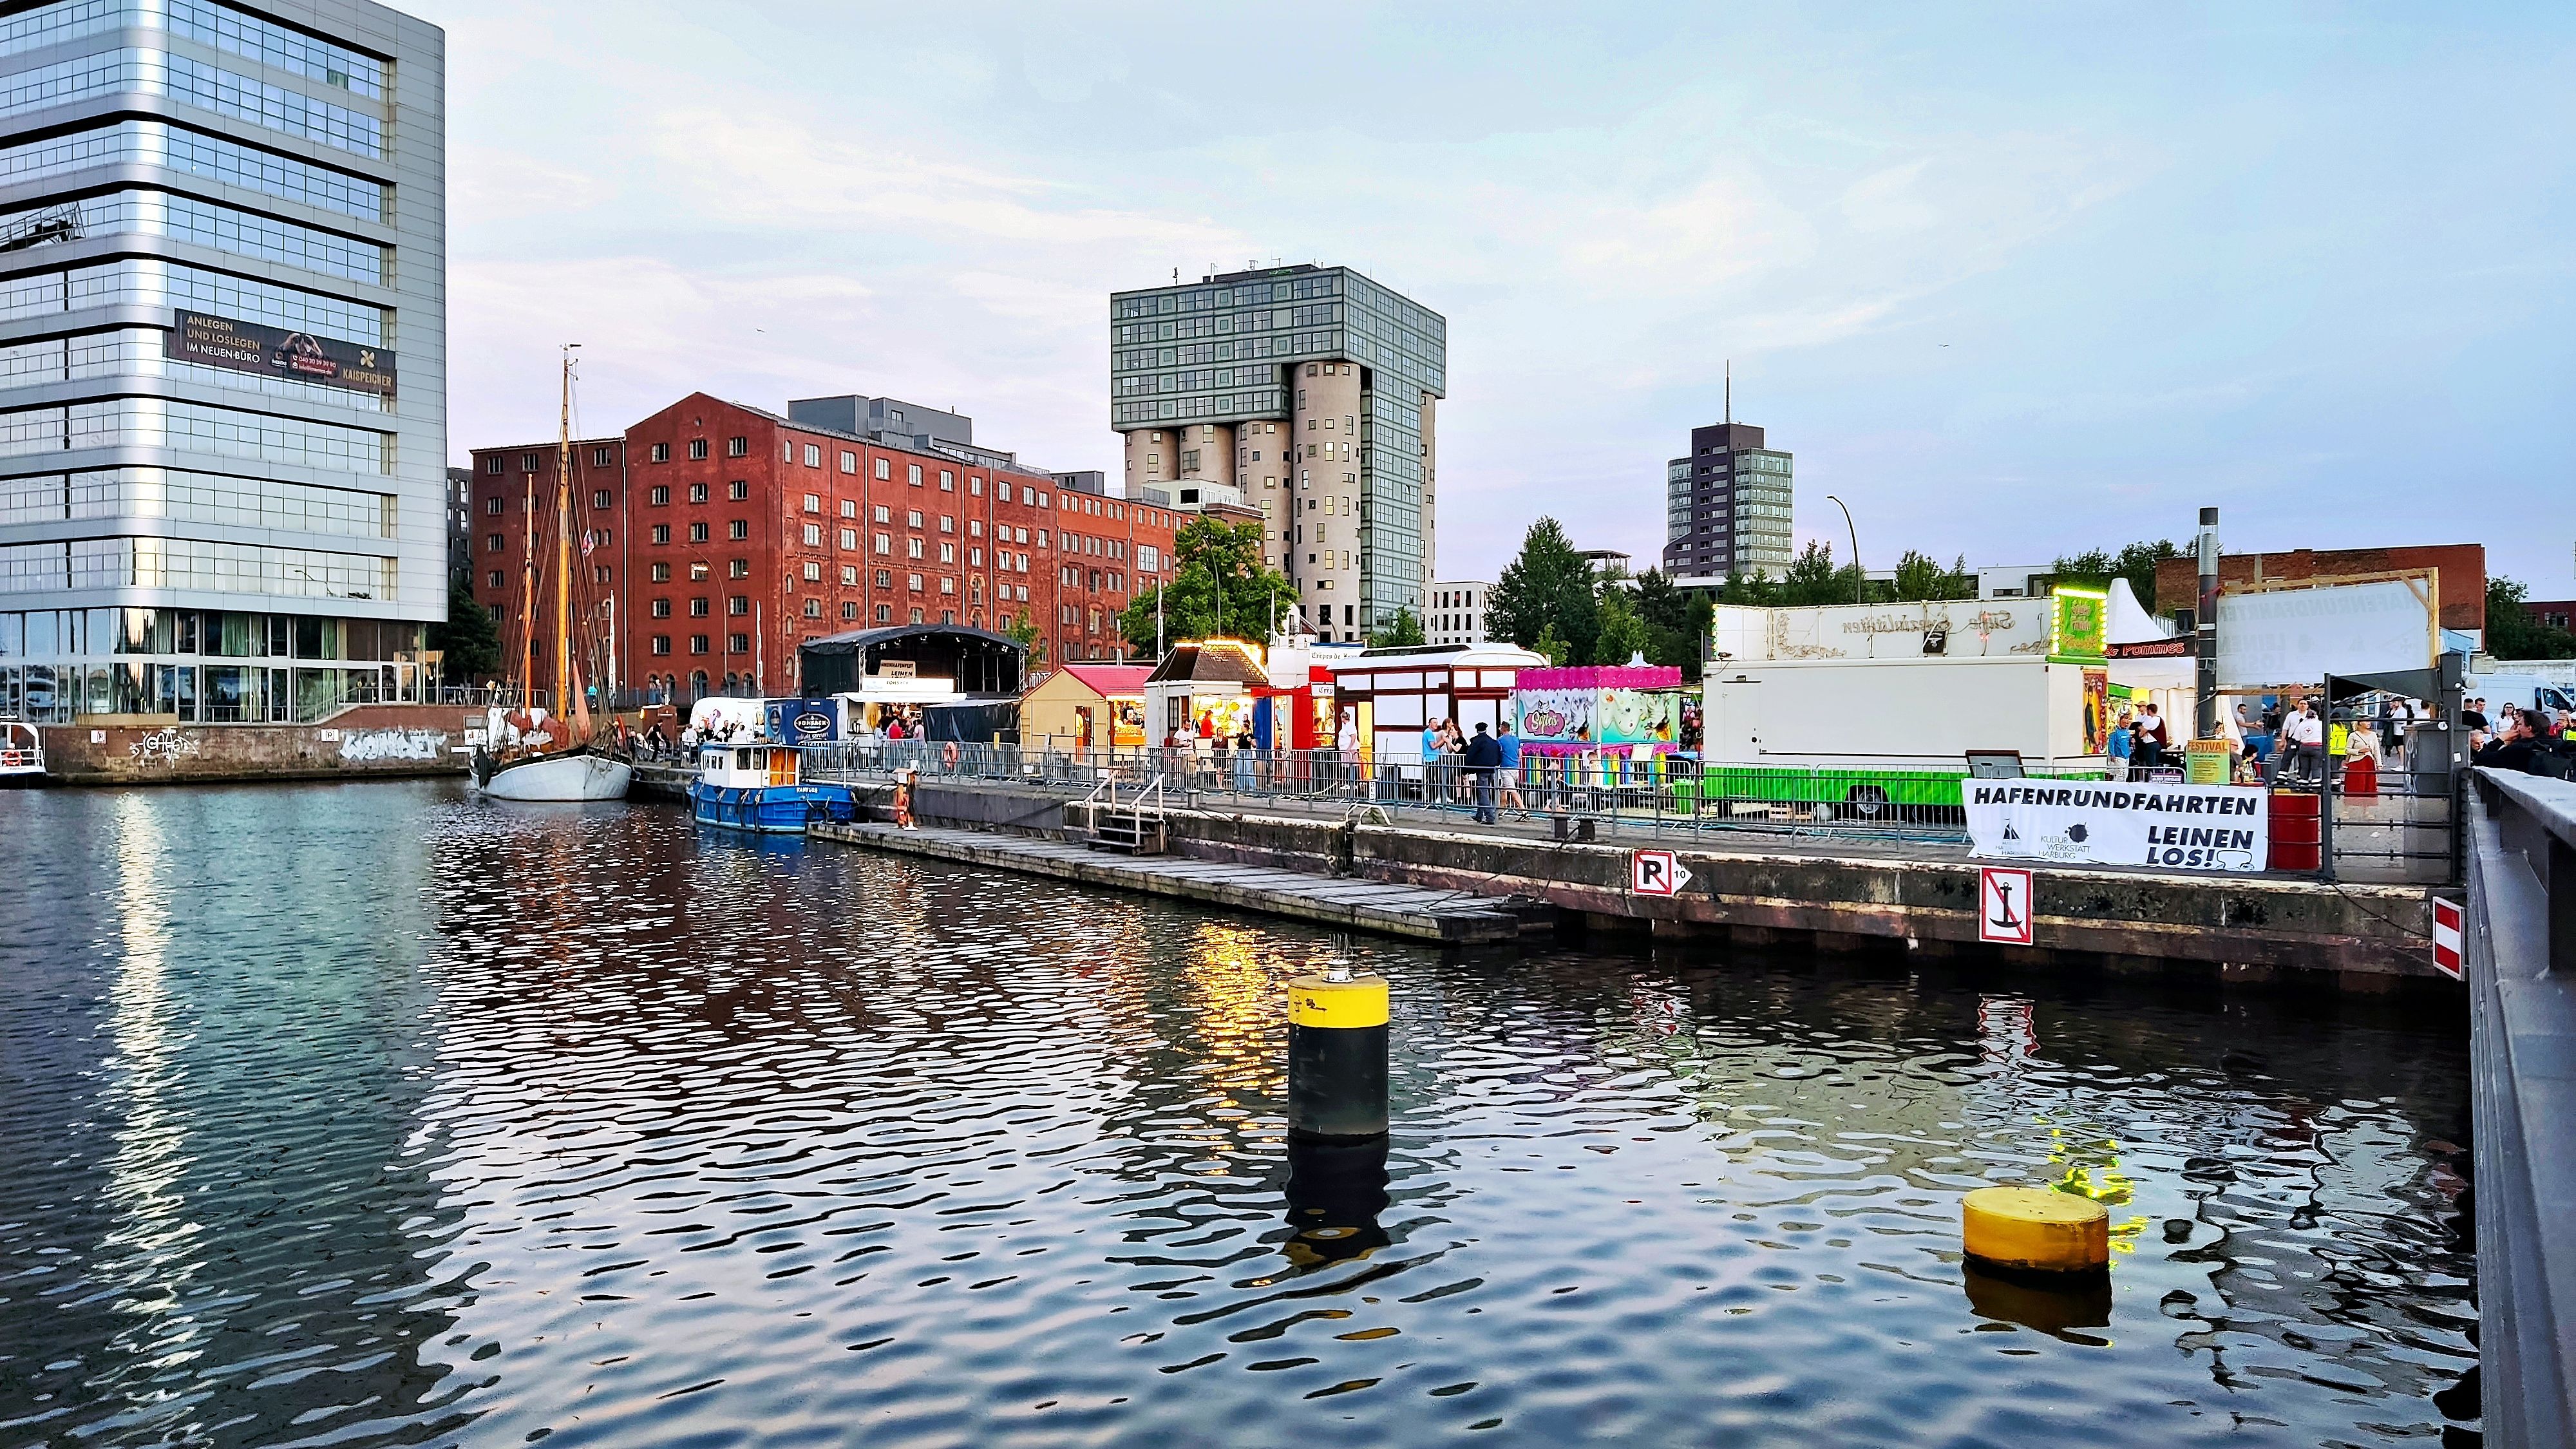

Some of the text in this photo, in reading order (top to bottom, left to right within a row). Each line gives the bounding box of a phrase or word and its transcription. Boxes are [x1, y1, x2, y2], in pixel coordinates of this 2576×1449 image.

[187, 315, 233, 332] ANLEGEN
[187, 329, 260, 350] UND LOSLEGEN
[187, 342, 198, 352] IM
[201, 345, 232, 359] NEUEN
[234, 349, 260, 363] BÜRO
[343, 368, 392, 386] KAISPEICHER
[2123, 643, 2184, 656] Pommes
[2188, 742, 2228, 752] FESTIVAL
[1974, 787, 2257, 815] HAFENRUNDFAHRTEN
[2041, 835, 2068, 844] KULTUR
[2148, 826, 2253, 849] LEINEN
[2038, 850, 2076, 859] HARBURG
[2047, 844, 2090, 853] WERKSTATT
[2146, 847, 2213, 867] LOS!
[1643, 860, 1686, 884] P 10
